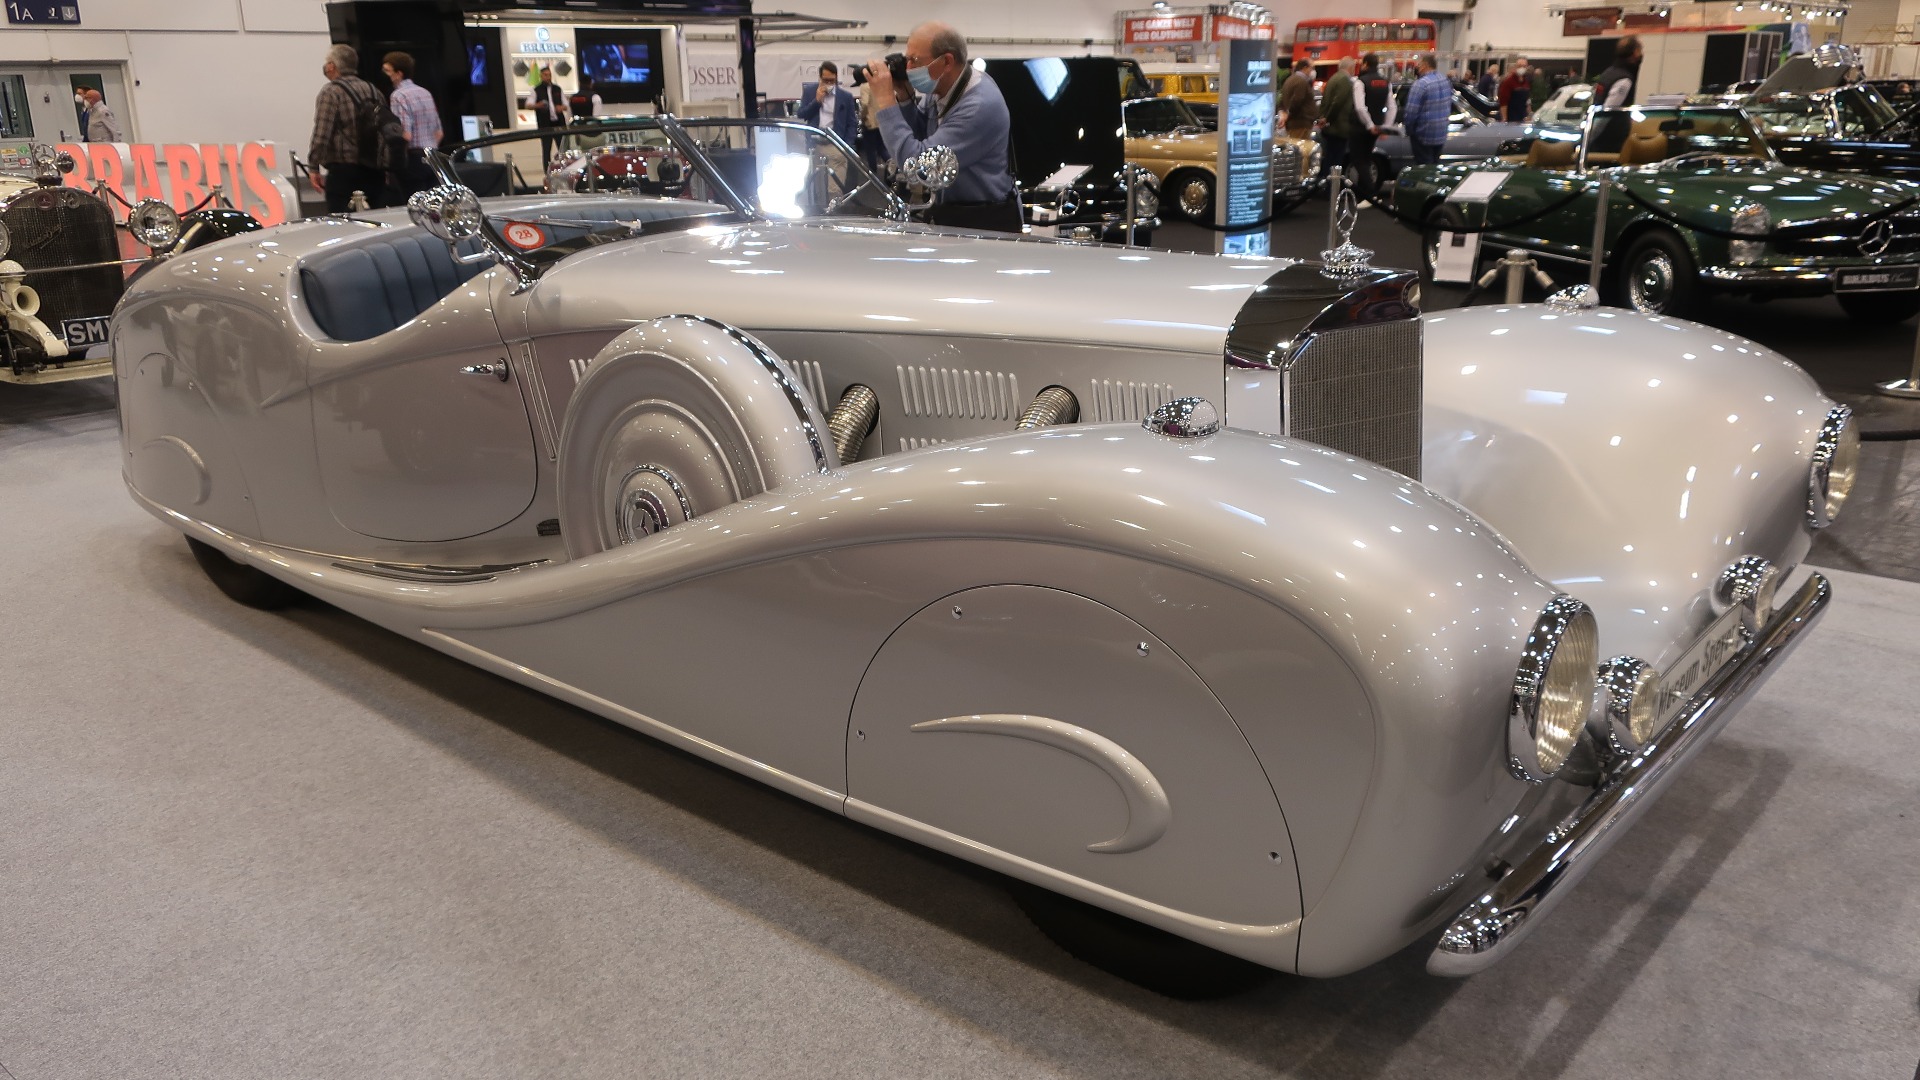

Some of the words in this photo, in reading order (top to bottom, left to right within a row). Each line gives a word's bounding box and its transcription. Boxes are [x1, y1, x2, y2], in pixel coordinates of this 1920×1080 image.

[9, 2, 34, 20] 1A
[55, 142, 286, 229] BRABUS
[515, 229, 533, 240] 28
